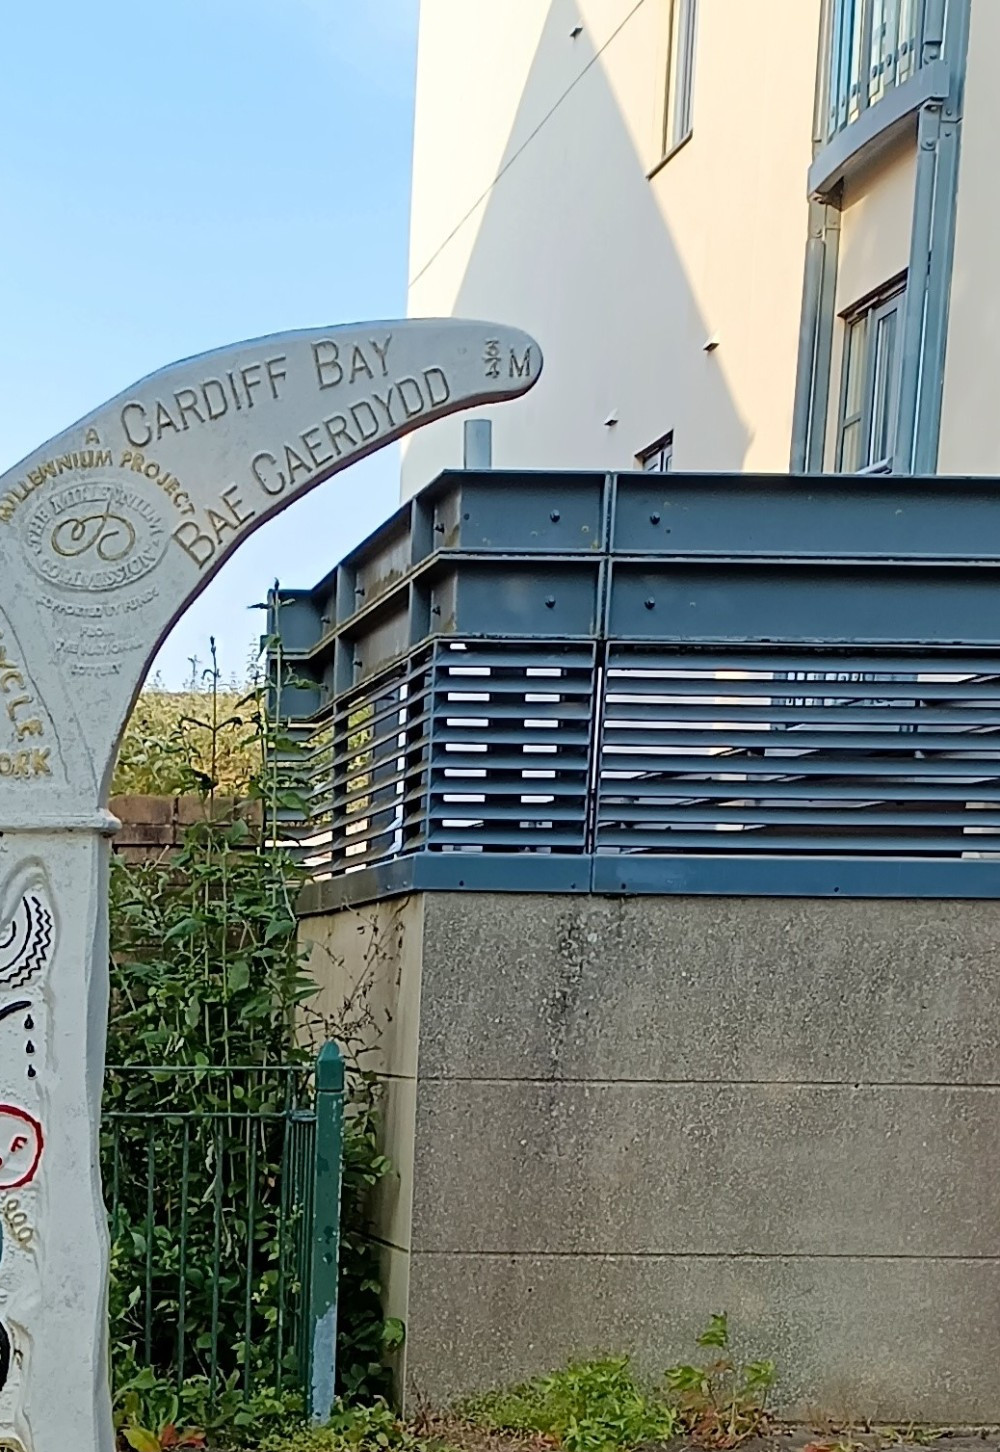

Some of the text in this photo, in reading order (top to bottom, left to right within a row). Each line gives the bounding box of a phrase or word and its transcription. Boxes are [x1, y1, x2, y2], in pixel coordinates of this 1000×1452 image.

[121, 335, 391, 447] CARDIFF BAY
[85, 427, 101, 445] A
[171, 366, 450, 570] BAE CAERDYDD
[119, 451, 196, 516] PROJECT
[10, 1136, 28, 1153] F
